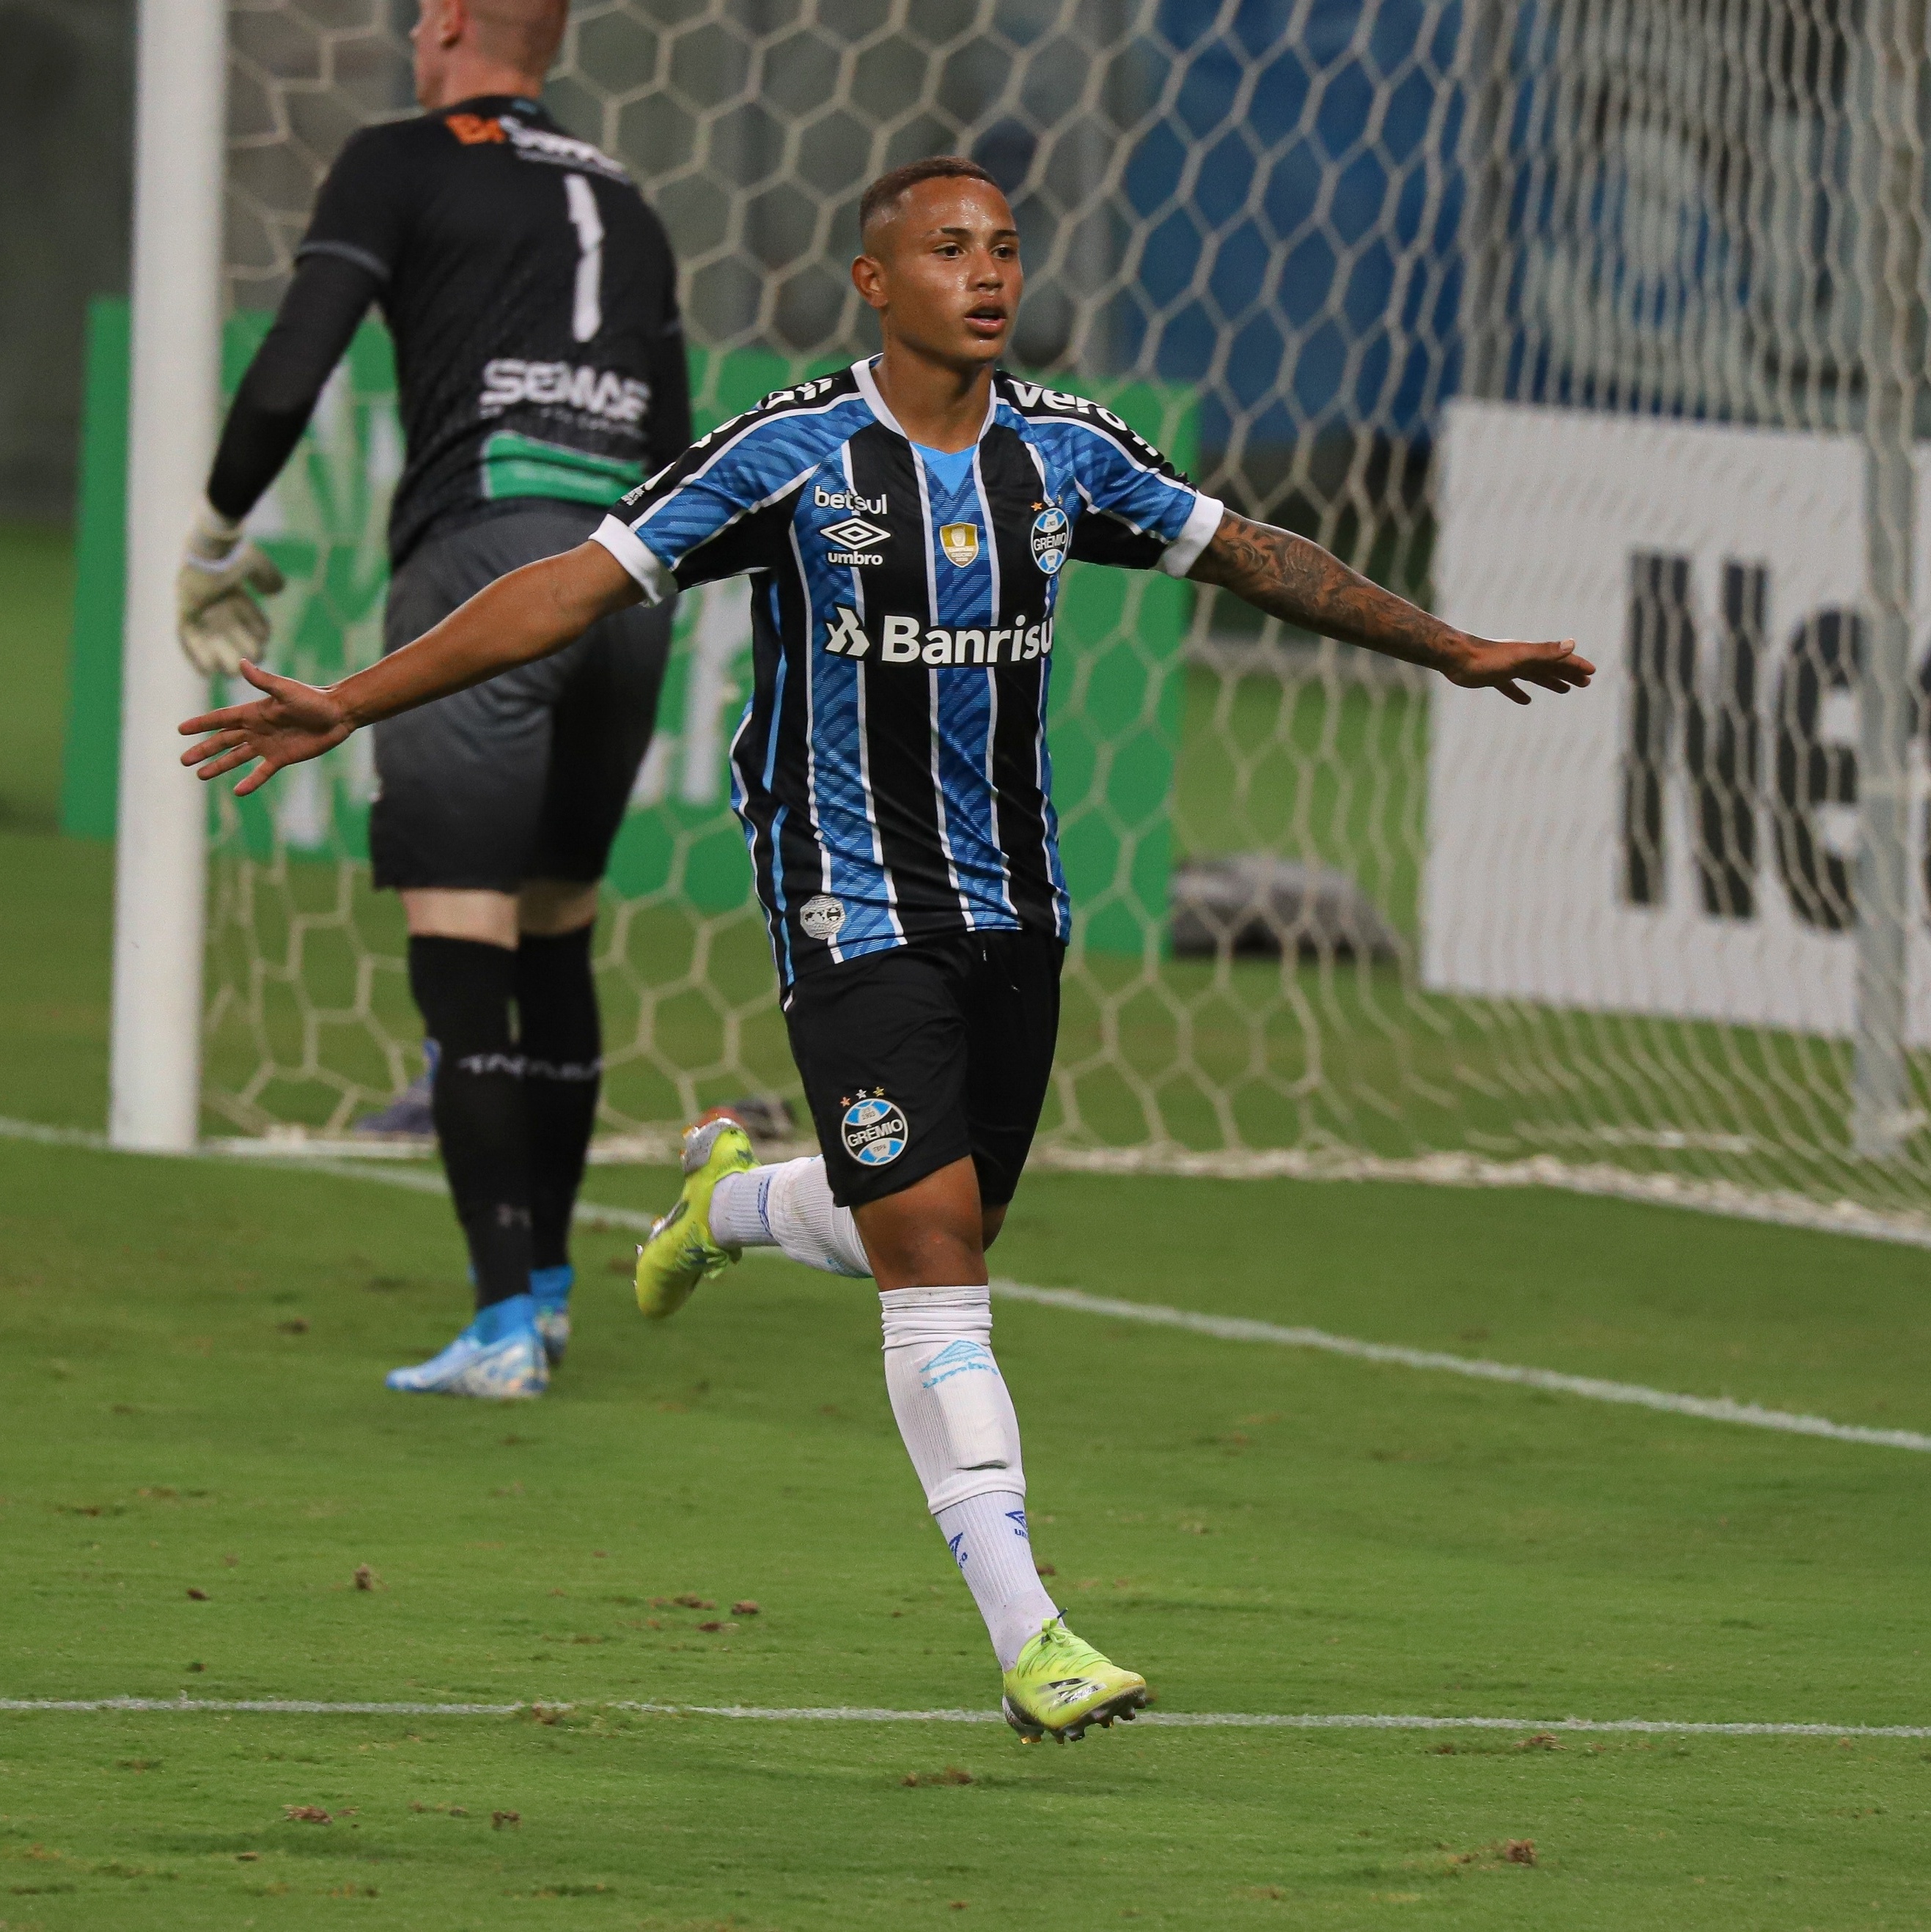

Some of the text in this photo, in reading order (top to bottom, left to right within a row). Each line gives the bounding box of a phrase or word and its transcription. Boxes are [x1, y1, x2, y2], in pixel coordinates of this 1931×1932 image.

[562, 173, 605, 342] 1
[814, 486, 887, 515] betsul
[1034, 533, 1067, 551] GRÊMIO
[828, 551, 883, 565] umbro
[847, 1119, 903, 1147] GRÊMIO
